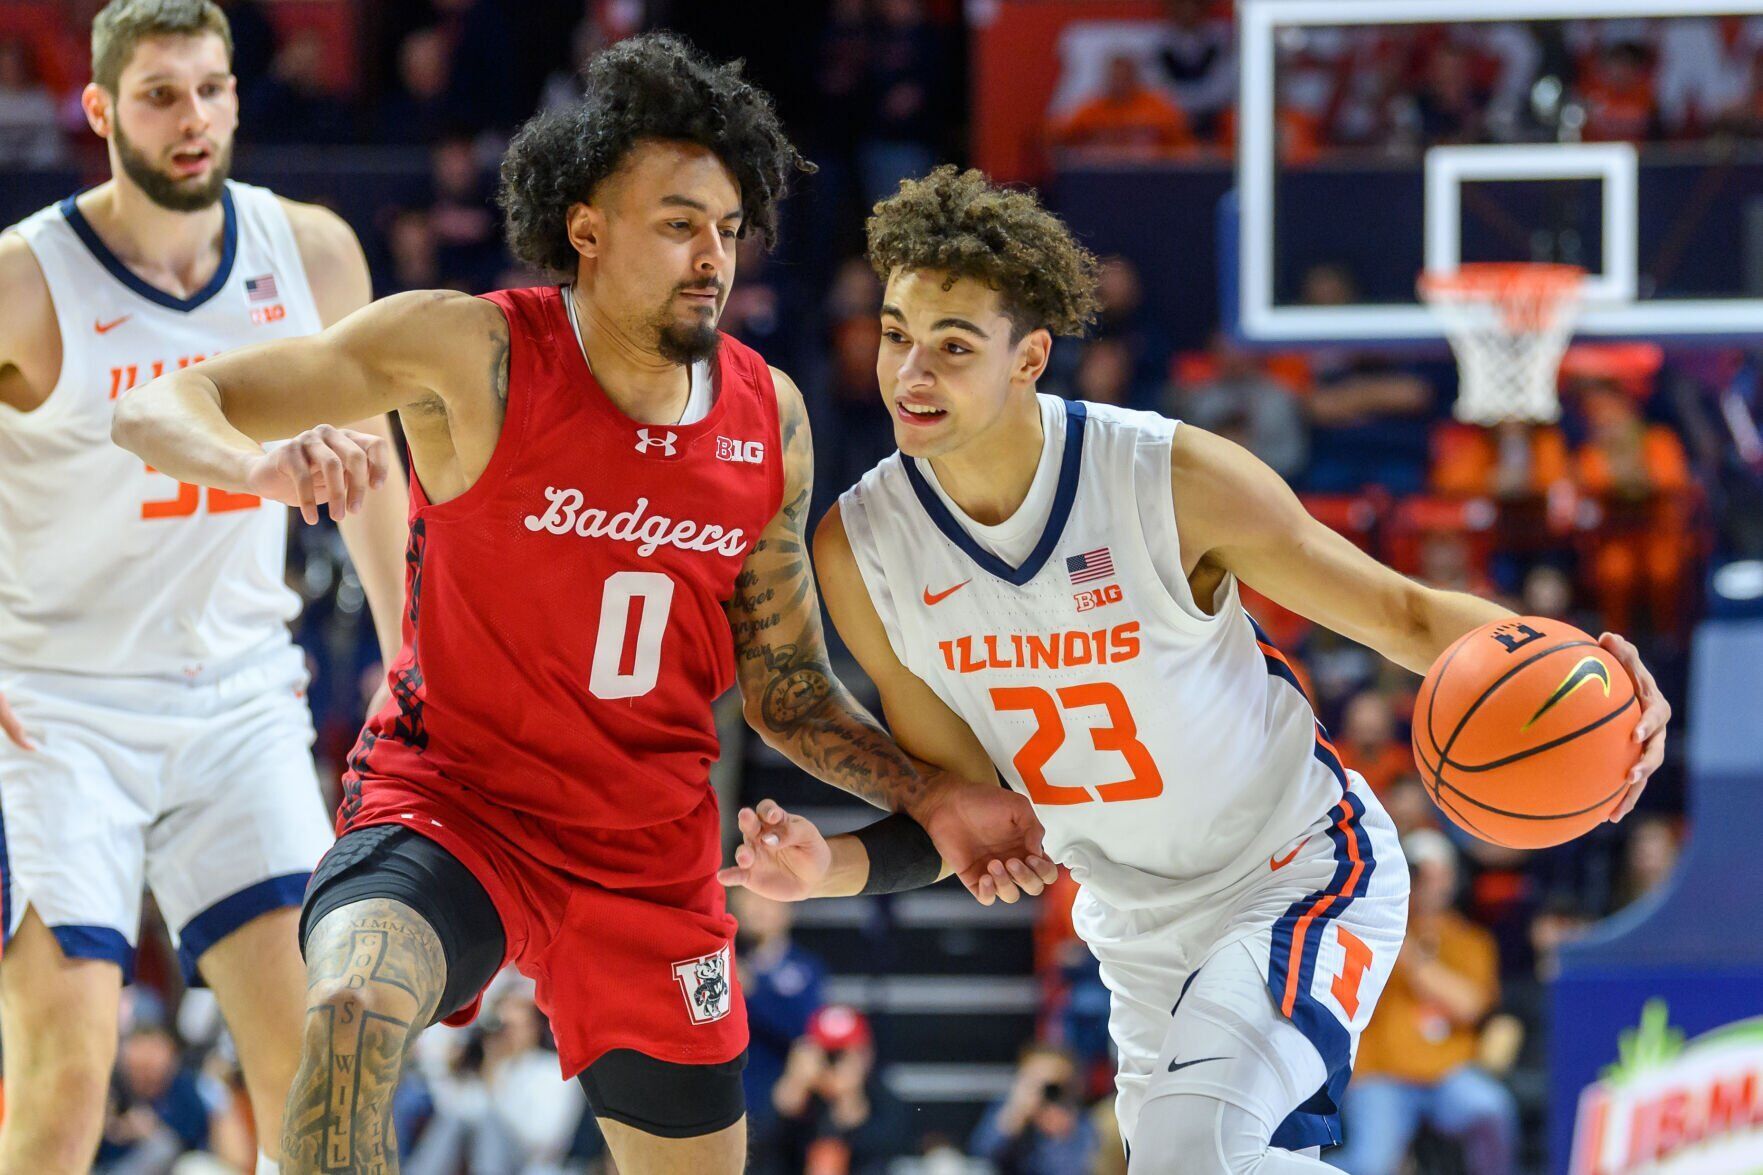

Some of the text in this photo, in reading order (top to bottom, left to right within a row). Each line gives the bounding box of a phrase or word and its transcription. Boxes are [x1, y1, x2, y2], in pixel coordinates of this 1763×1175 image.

[524, 486, 747, 557] Badgers
[589, 571, 675, 700] 0
[938, 620, 1141, 674] ILLINOIS
[988, 682, 1164, 806] 23
